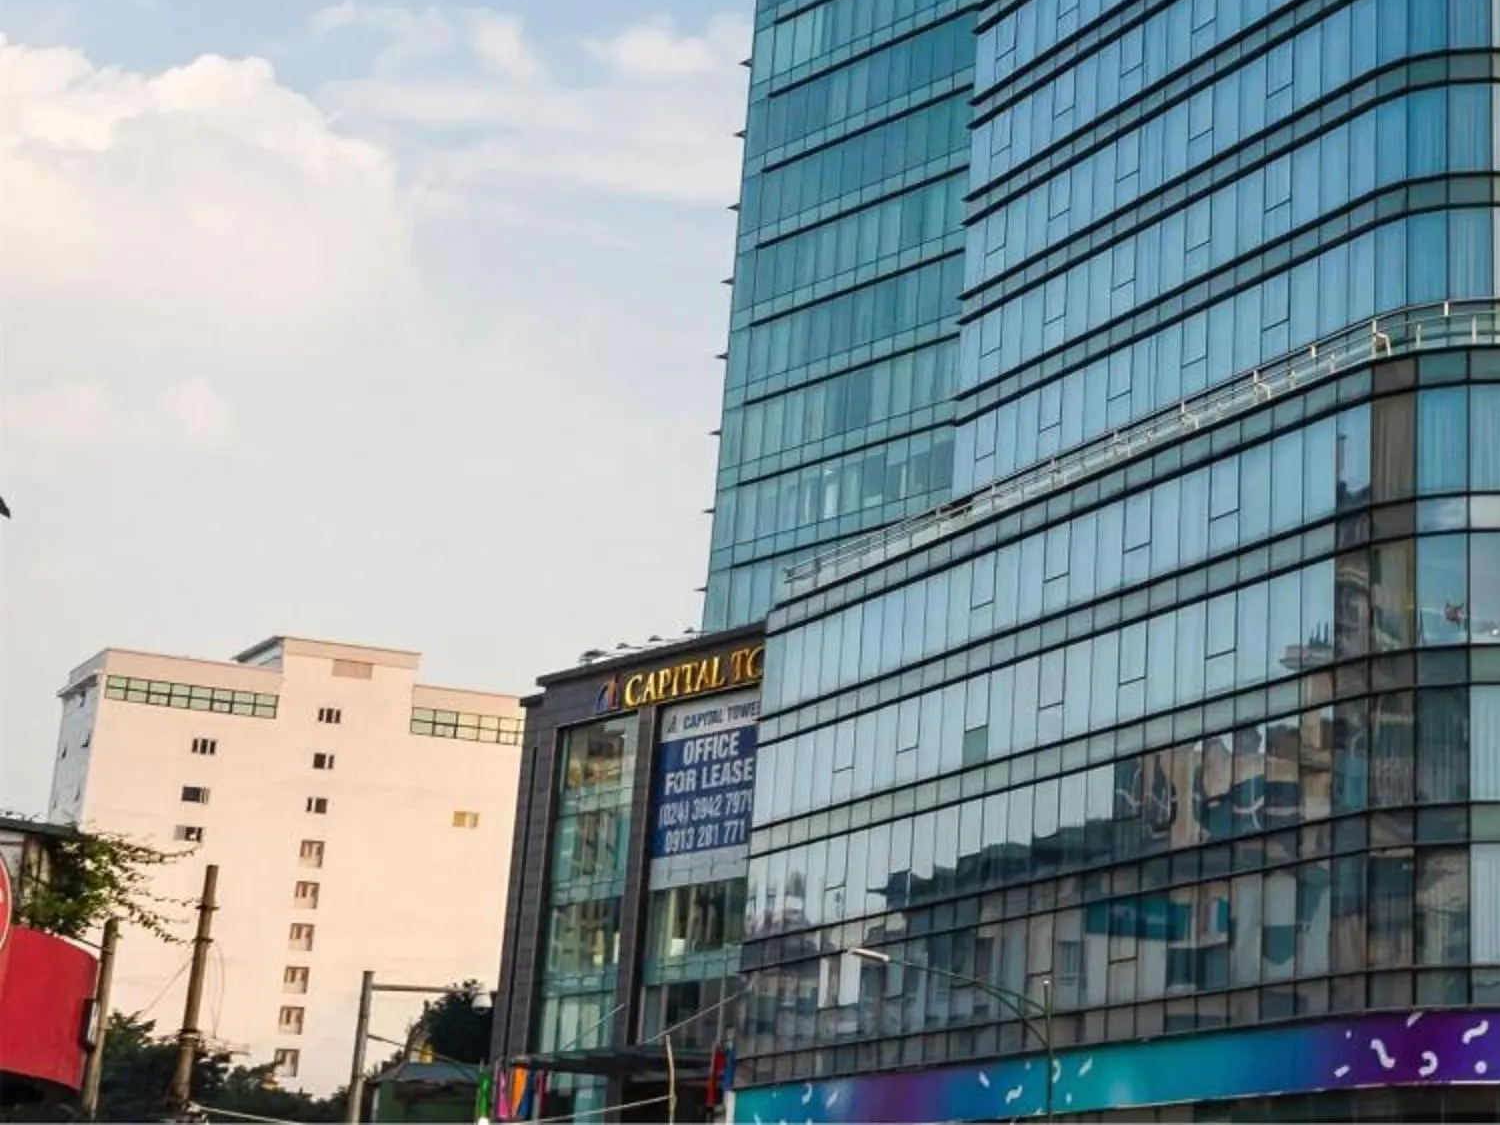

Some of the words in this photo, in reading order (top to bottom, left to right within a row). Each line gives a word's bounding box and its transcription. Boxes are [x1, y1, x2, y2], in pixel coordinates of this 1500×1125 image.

[624, 655, 726, 707] CAPITAL
[683, 731, 740, 766] OFFICE
[664, 768, 698, 797] FOR
[701, 758, 755, 790] LEASE
[722, 817, 747, 844] 771
